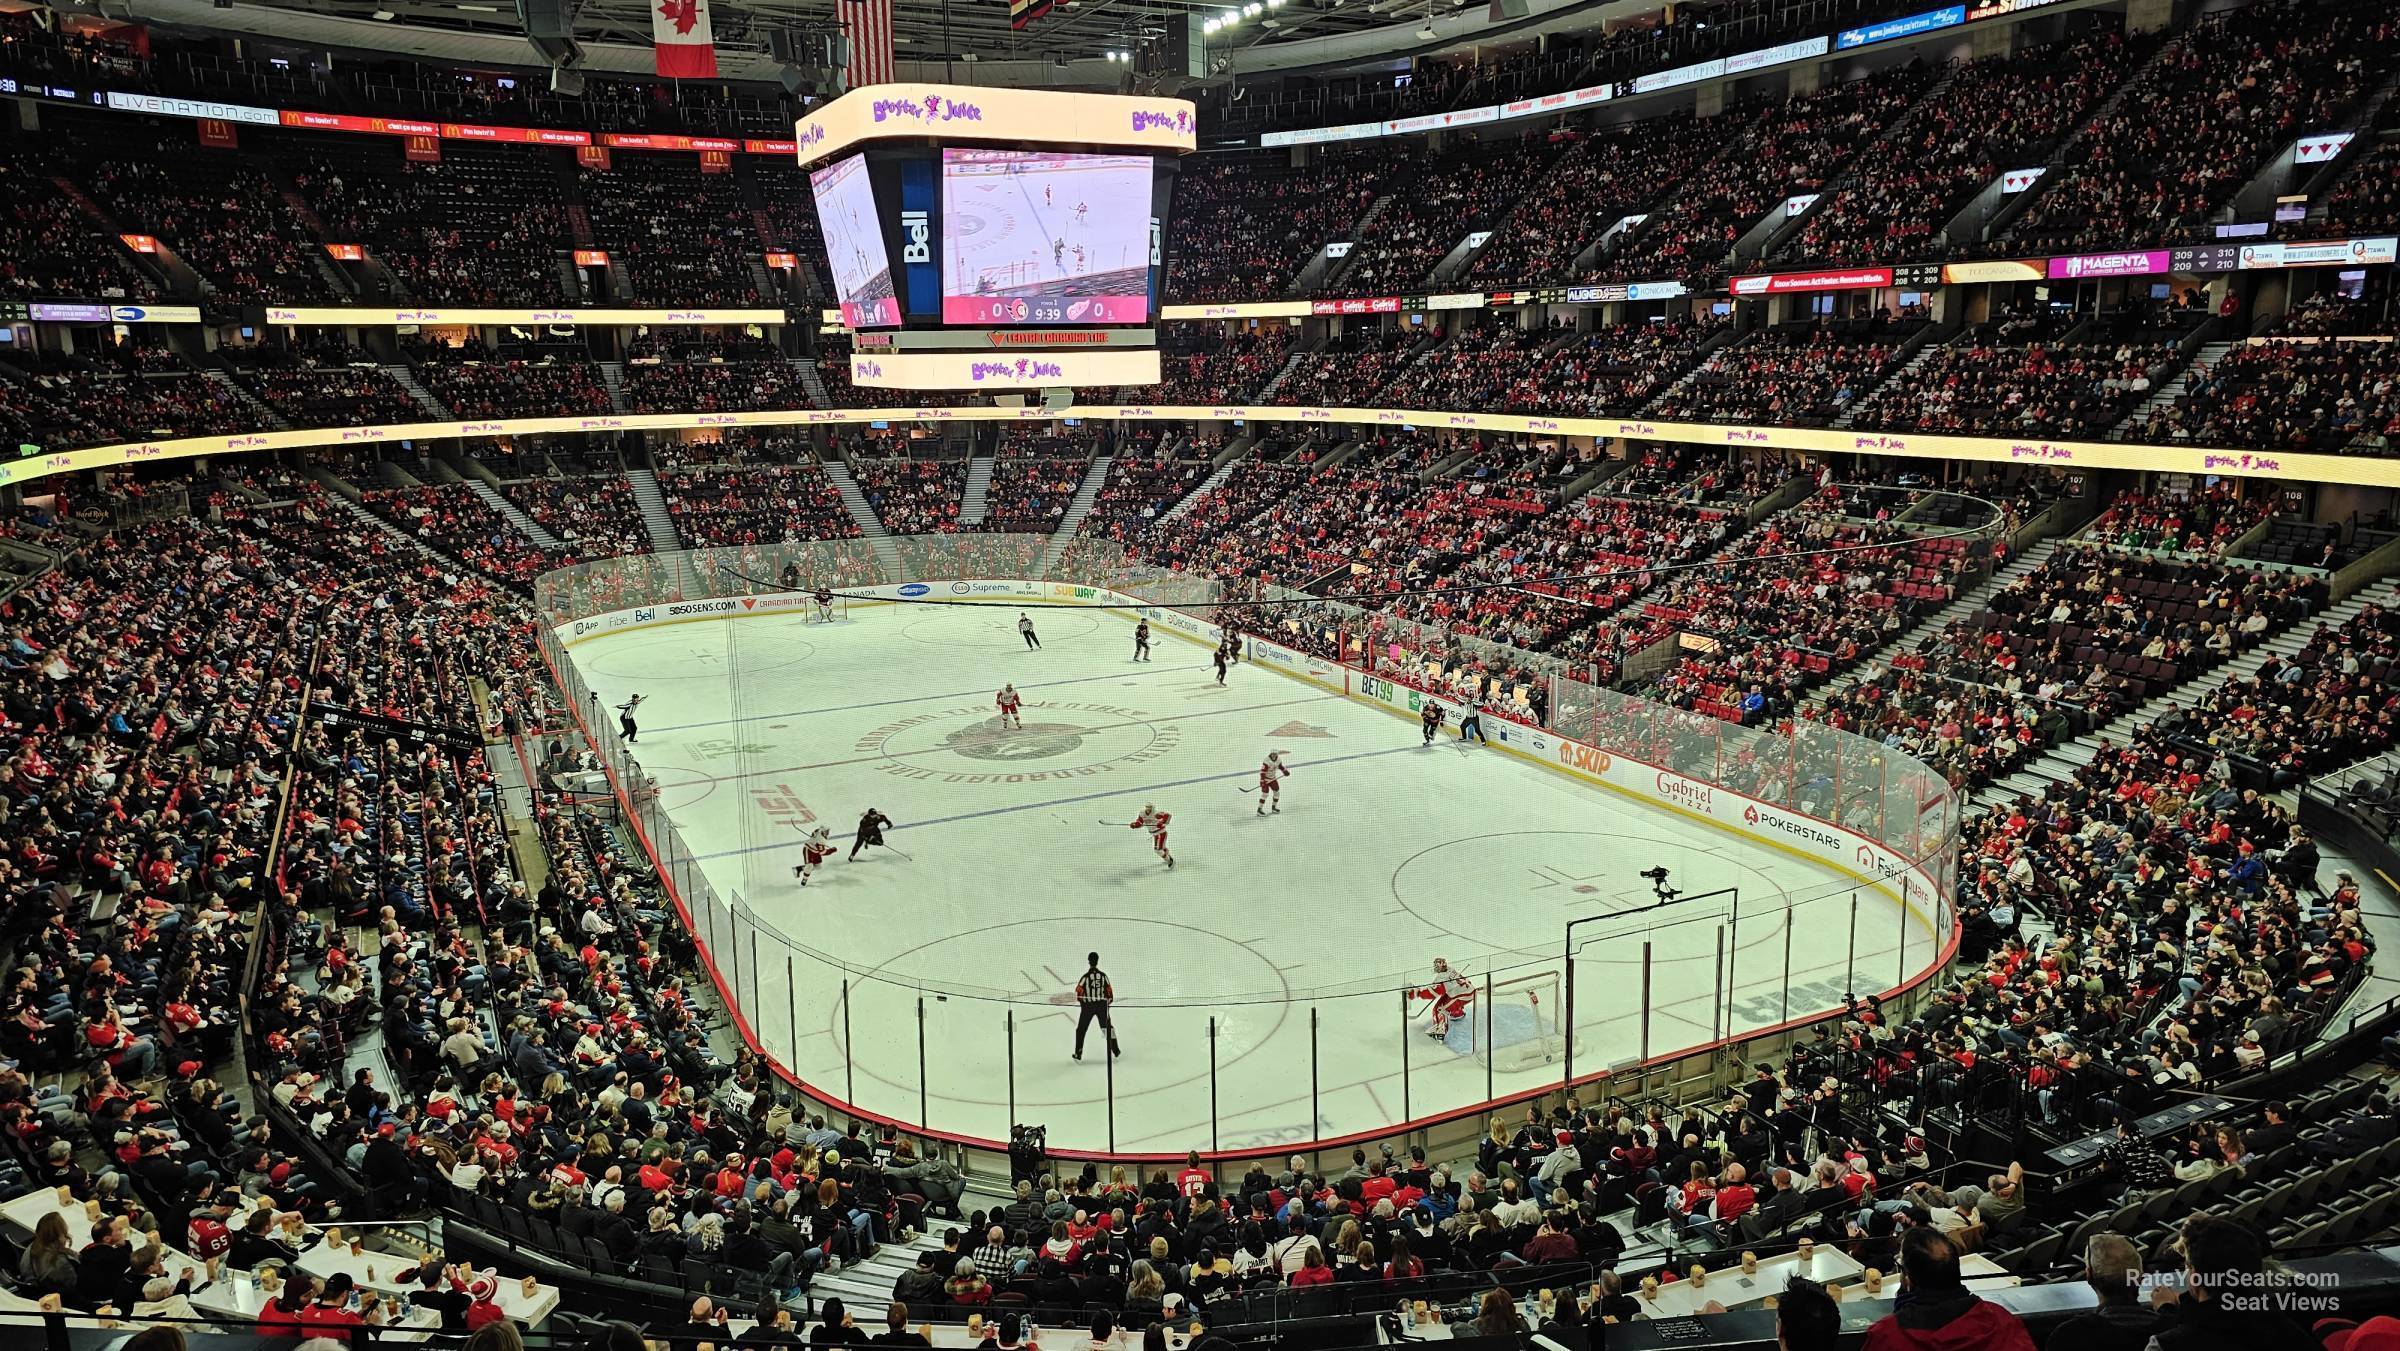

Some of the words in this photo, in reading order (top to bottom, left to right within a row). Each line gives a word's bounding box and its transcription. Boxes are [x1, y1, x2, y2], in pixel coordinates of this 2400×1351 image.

[872, 98, 924, 122] Booster
[942, 100, 982, 122] Juice
[1132, 110, 1176, 132] Booster
[901, 210, 930, 263] Bell
[2174, 250, 2193, 260] 309
[2217, 248, 2234, 257] 310
[2084, 255, 2150, 269] MAGENTA
[2174, 262, 2192, 271] 209
[2216, 260, 2234, 269] 210
[1895, 268, 1908, 276] 308
[1924, 266, 1938, 274] 309
[2114, 266, 2150, 274] SOLUTIONS
[1774, 280, 1790, 288] Know
[1924, 276, 1938, 284] 209
[992, 302, 1002, 318] 0
[1036, 308, 1060, 320] 9:39
[1094, 302, 1104, 316] 0
[972, 362, 1014, 380] Booster
[1028, 362, 1062, 378] Juice
[2012, 446, 2039, 457] Booster
[2049, 447, 2072, 458] Juice
[2204, 455, 2239, 468] Booster
[2252, 458, 2280, 470] Juice
[2070, 476, 2084, 484] 107
[2285, 491, 2302, 500] 108
[972, 583, 1010, 593] Supreme
[1055, 584, 1097, 599] SUBWAY
[669, 600, 736, 616] 5050SENS.COM
[759, 598, 793, 608] CANADIAN
[635, 608, 656, 622] Bell
[1268, 646, 1294, 664] Supreme
[1362, 674, 1394, 702] BET99
[340, 716, 388, 730] brookstreet
[1574, 746, 1612, 774] SKIP
[1656, 772, 1713, 804] Gabriel
[1672, 794, 1713, 815] PIZZA
[1761, 812, 1840, 850] POKERSTARS
[210, 1234, 228, 1250] 65
[1247, 1258, 1268, 1268] CHABOT
